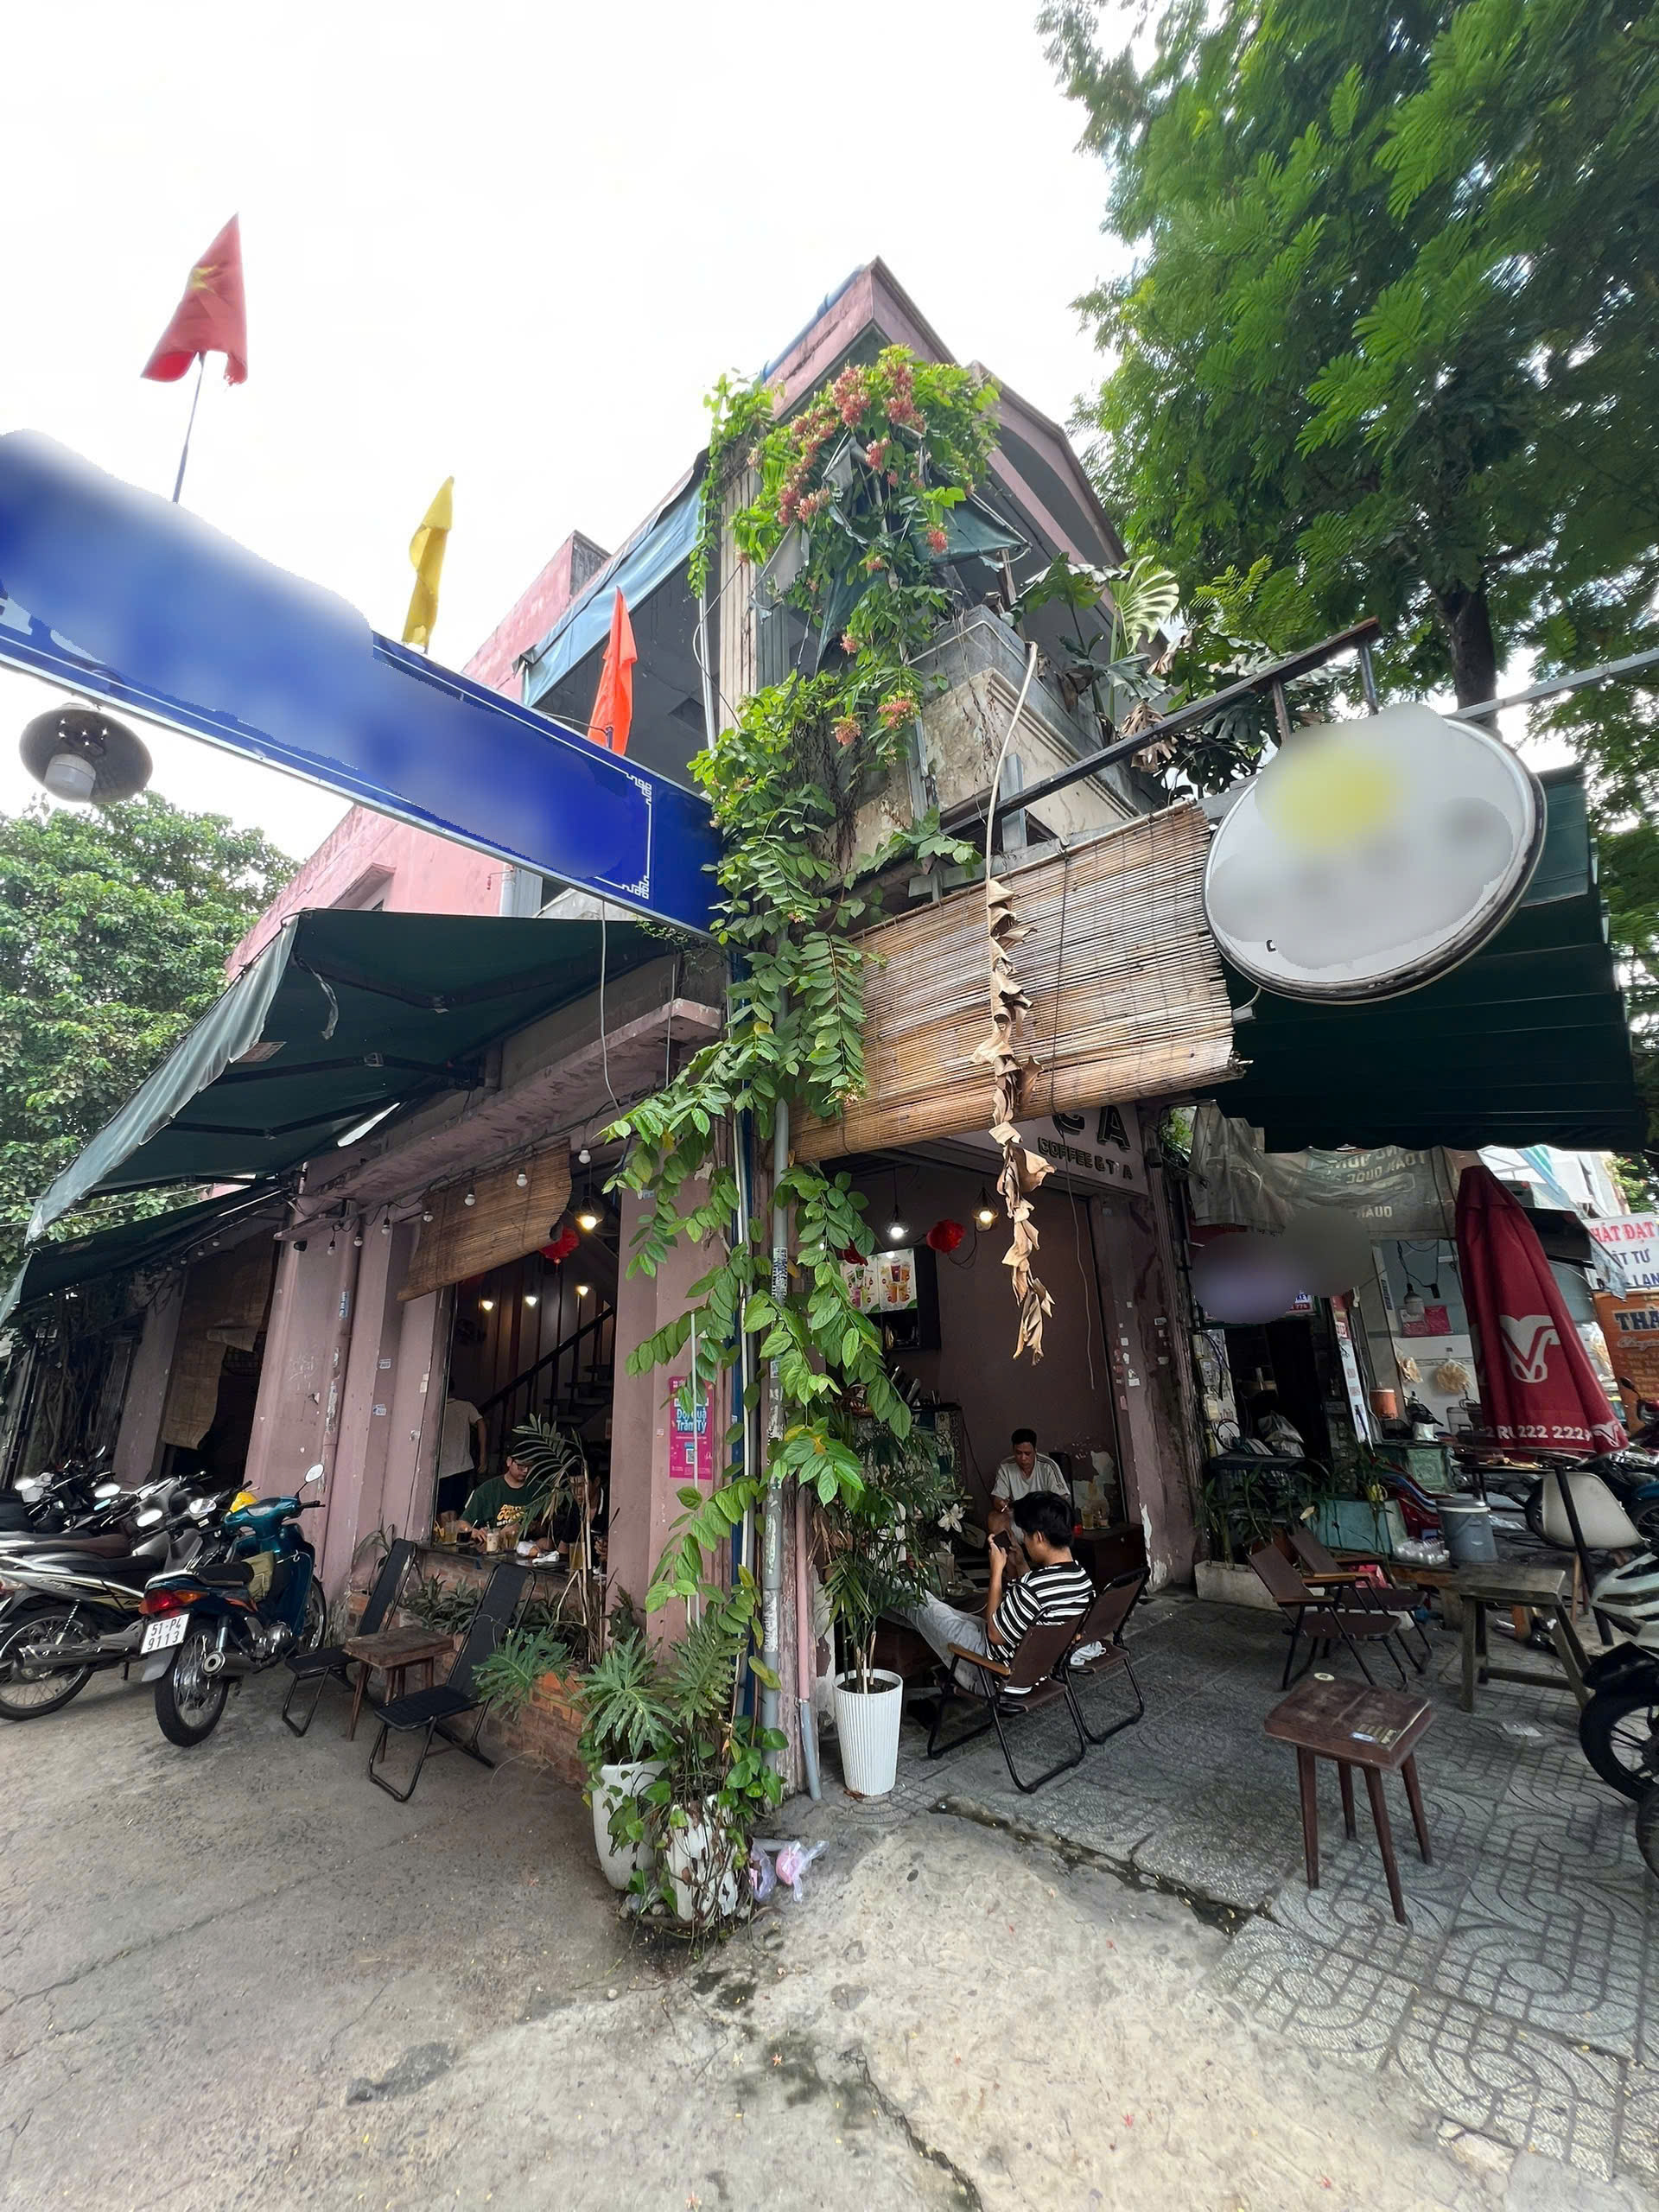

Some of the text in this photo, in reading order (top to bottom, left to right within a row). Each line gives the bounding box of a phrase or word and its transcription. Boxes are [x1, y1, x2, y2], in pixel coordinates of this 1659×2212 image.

[1038, 1137, 1093, 1168] COFFEE
[1622, 1221, 1656, 1243] ĐẠT
[148, 1630, 180, 1650] 9113
